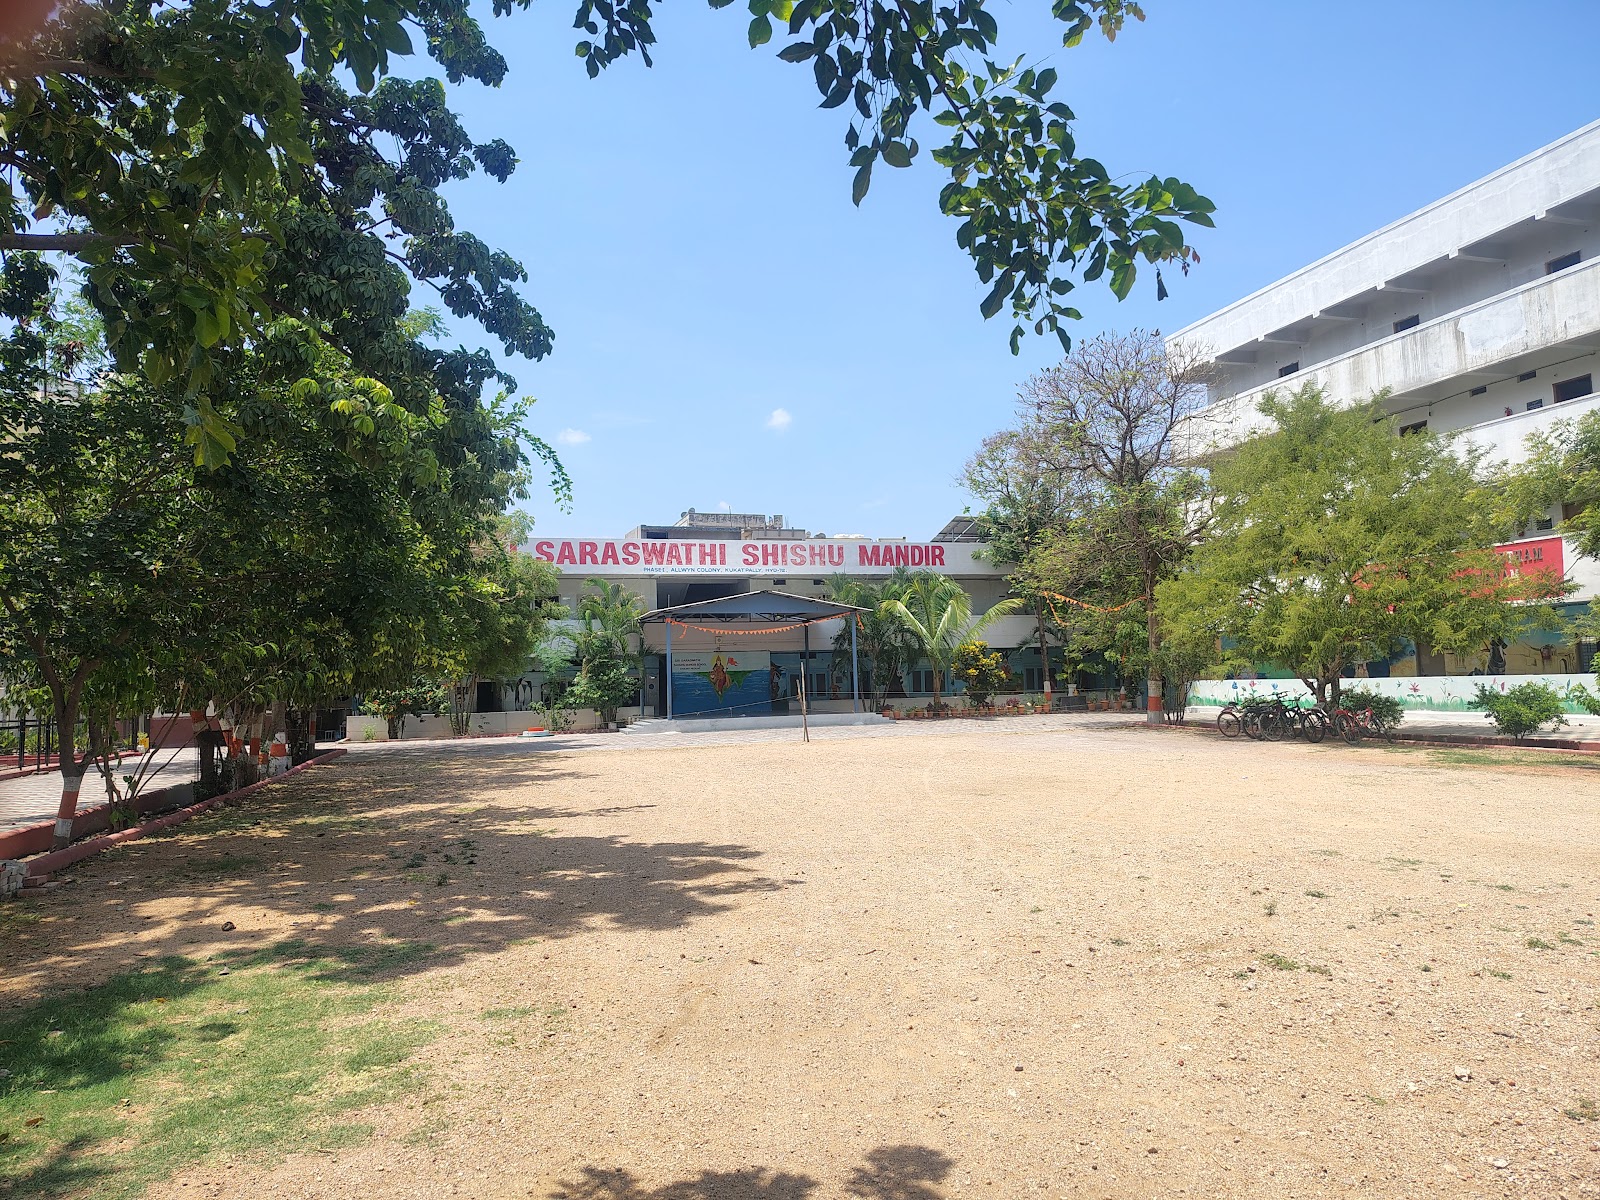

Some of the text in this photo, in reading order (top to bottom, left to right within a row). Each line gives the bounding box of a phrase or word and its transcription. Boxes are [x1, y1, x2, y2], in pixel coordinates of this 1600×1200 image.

[535, 541, 727, 566] SARASWATHI
[742, 543, 844, 566] SHISHU
[858, 545, 945, 566] MANDIR
